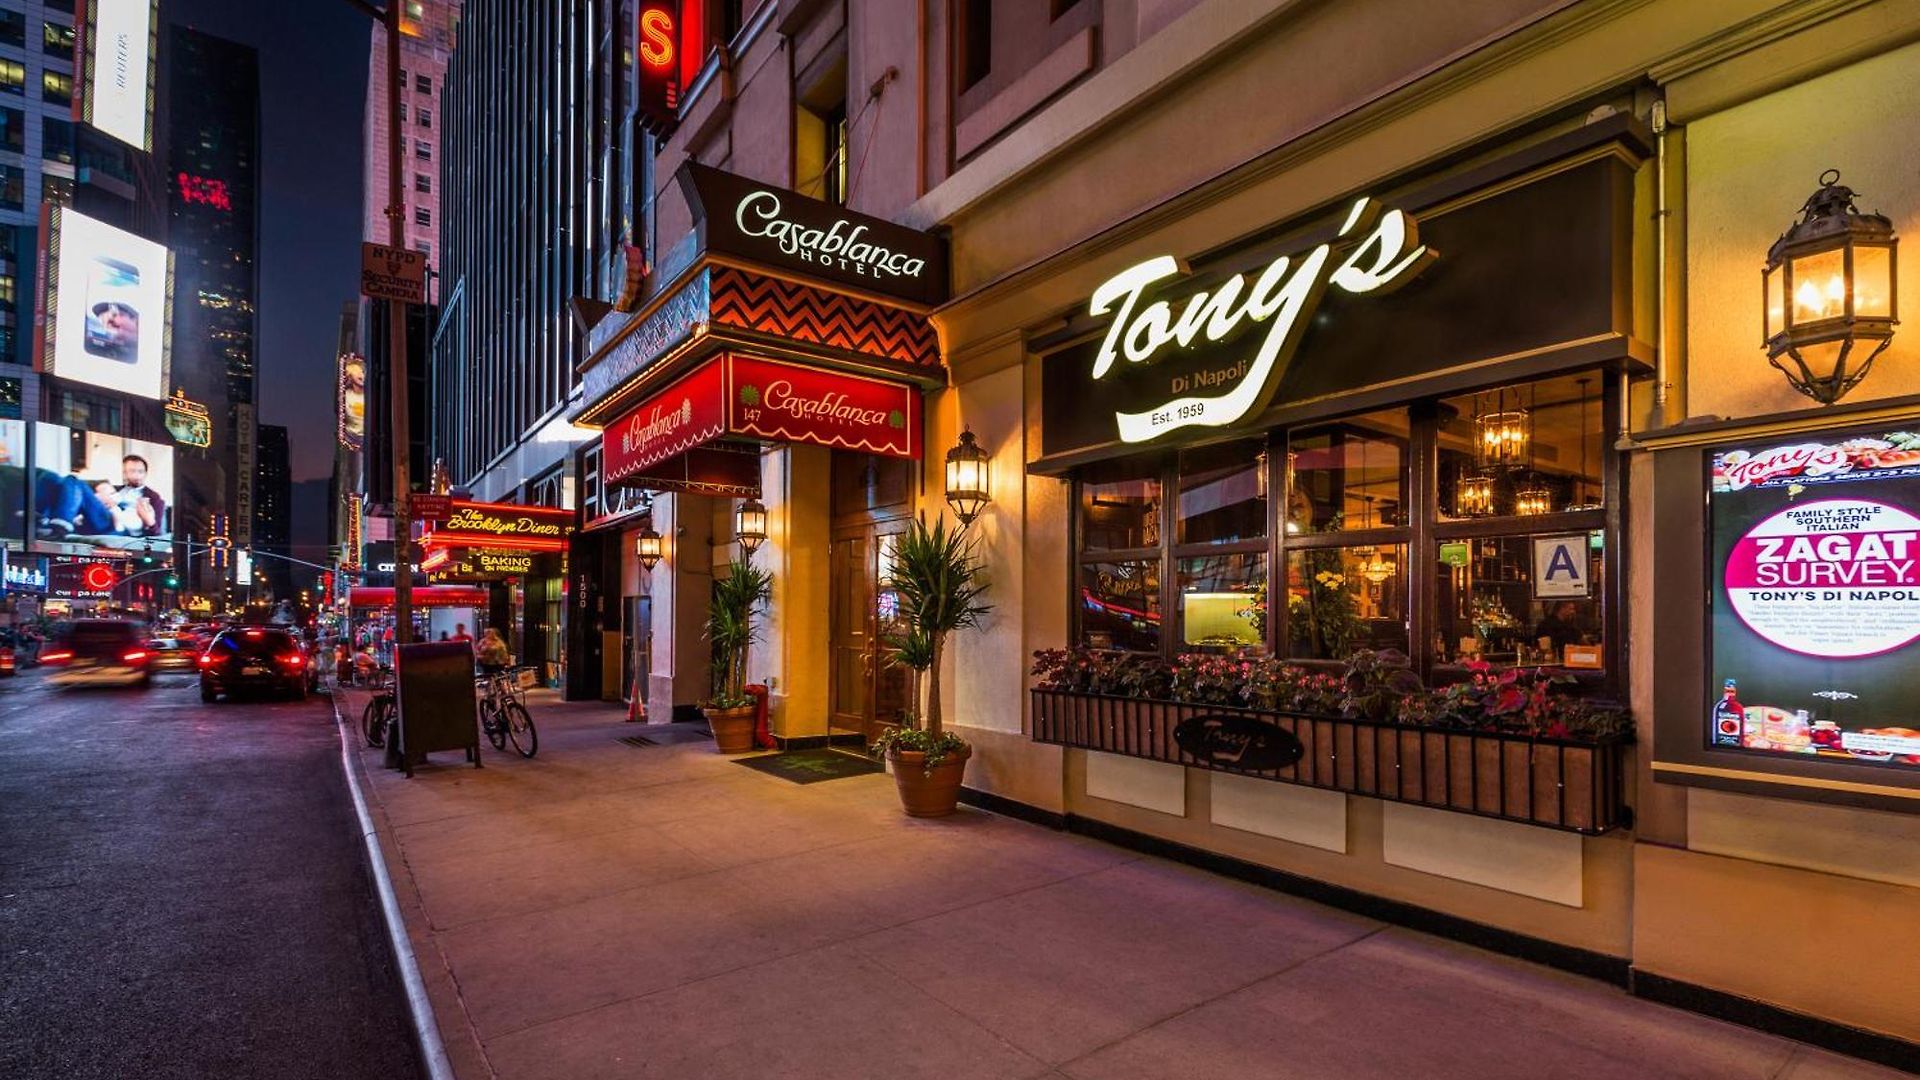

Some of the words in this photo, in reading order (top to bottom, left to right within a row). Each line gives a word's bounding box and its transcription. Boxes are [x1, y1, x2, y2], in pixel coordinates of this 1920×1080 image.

[736, 191, 925, 278] Casablanca
[373, 247, 416, 264] NYPD
[800, 249, 882, 279] HOTEL
[1090, 197, 1426, 443] Tony's
[1171, 376, 1189, 394] Di
[1193, 359, 1248, 389] Napoli
[744, 408, 761, 422] 147
[764, 380, 886, 425] Casablanca
[1151, 409, 1173, 426] Est.
[1177, 402, 1205, 420] 1959
[629, 404, 681, 454] Casablanca
[804, 413, 853, 426] HOTEL
[239, 409, 250, 465] HOTEL
[1727, 449, 1838, 483] Tony's
[239, 470, 250, 536] CARTER
[461, 509, 483, 520] The
[1786, 509, 1832, 519] FAMILY
[1837, 507, 1881, 516] STYLE
[447, 515, 516, 534] Brooklyn
[517, 518, 559, 534] Diner
[1796, 515, 1871, 525] SOUTHERN
[1807, 523, 1859, 532] ITALIAN
[481, 555, 531, 567] BAKING
[1756, 533, 1917, 563] ZAGAT
[1545, 545, 1579, 580] A
[1749, 592, 1816, 601] TONY'S
[1823, 592, 1841, 601] DI
